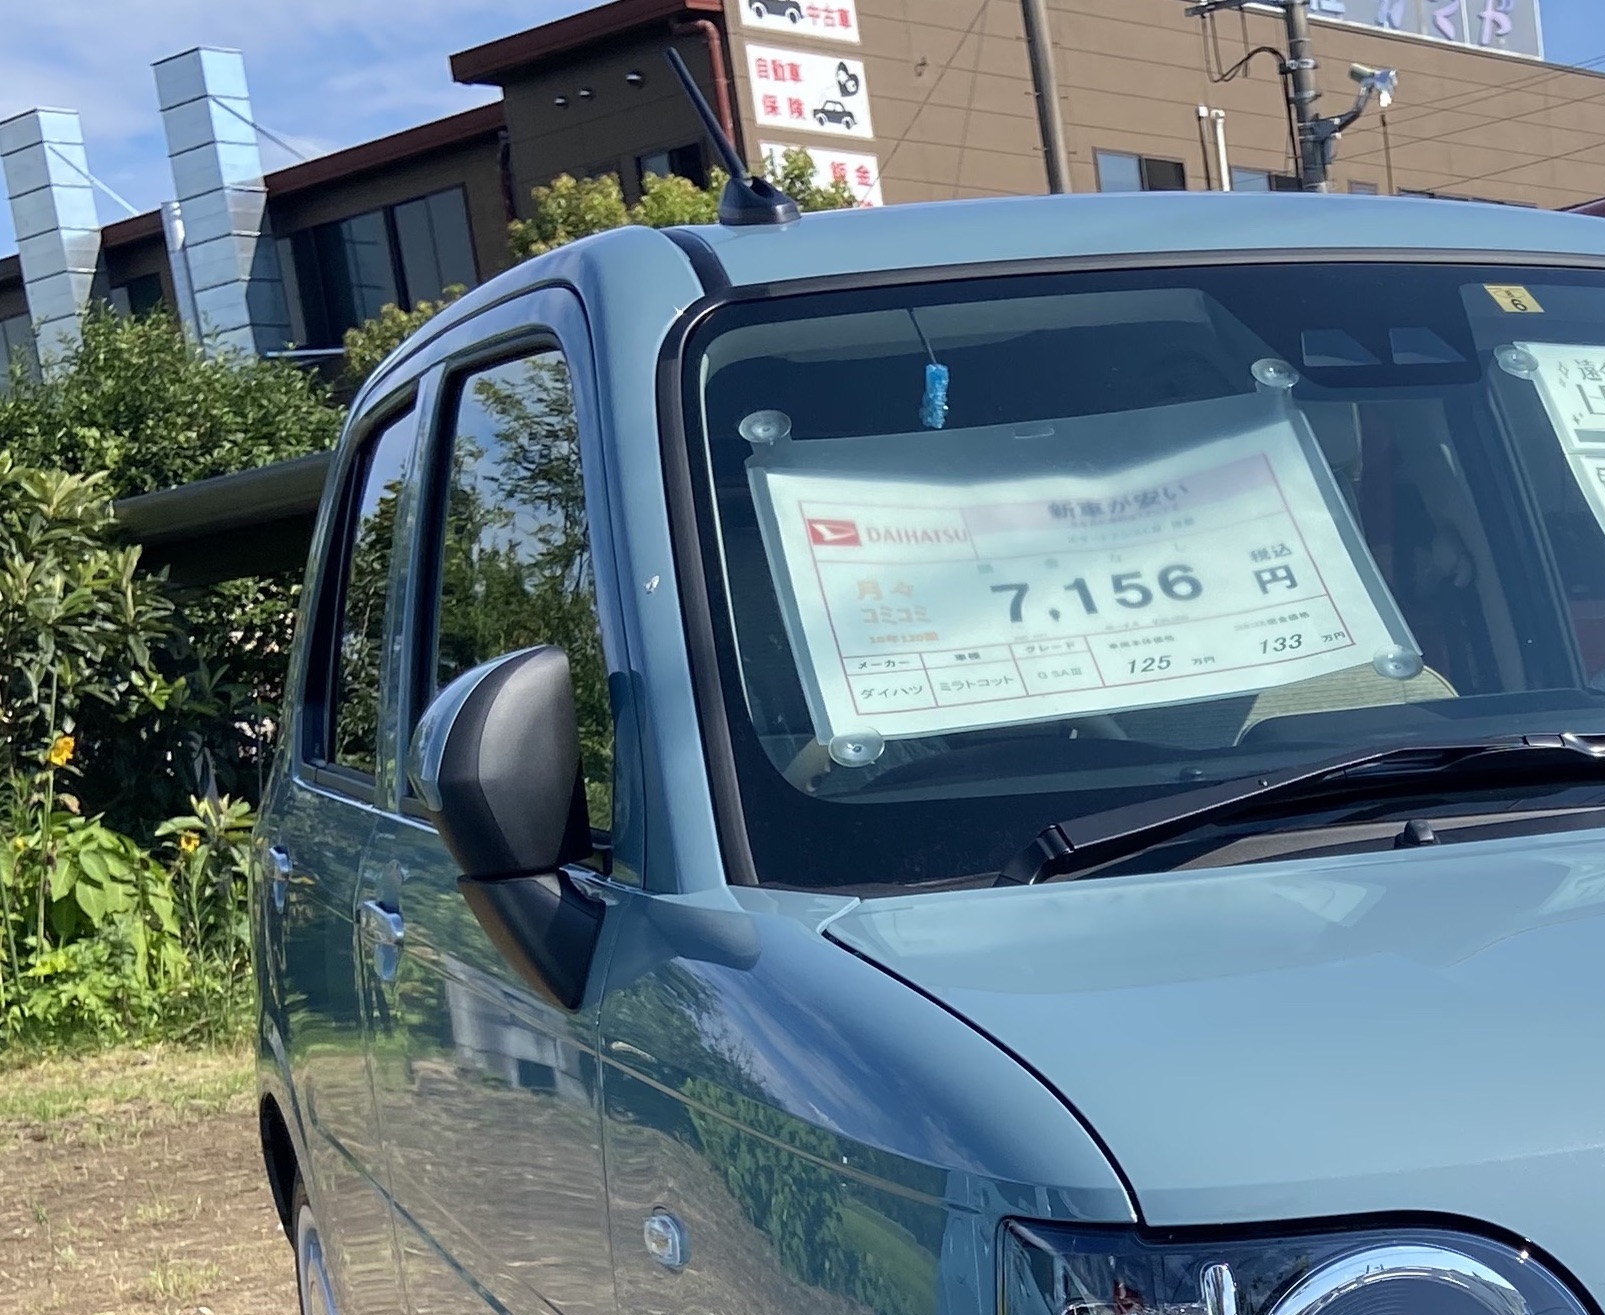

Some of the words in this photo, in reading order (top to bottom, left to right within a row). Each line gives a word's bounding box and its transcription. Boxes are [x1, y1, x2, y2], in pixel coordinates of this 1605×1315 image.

[756, 57, 804, 82] 自動車
[762, 94, 805, 120] 保険
[866, 528, 969, 545] DAIHATSU
[1250, 542, 1294, 563] 税込
[1252, 564, 1299, 595] 円
[989, 564, 1204, 623] 7,156
[1259, 633, 1303, 655] 133
[1321, 630, 1346, 643] 万円
[858, 659, 910, 670] メーカー
[1128, 654, 1173, 674] 125
[1191, 655, 1216, 666] 万円
[861, 685, 924, 700] ダイハツ
[939, 675, 1015, 692] ミラトコット
